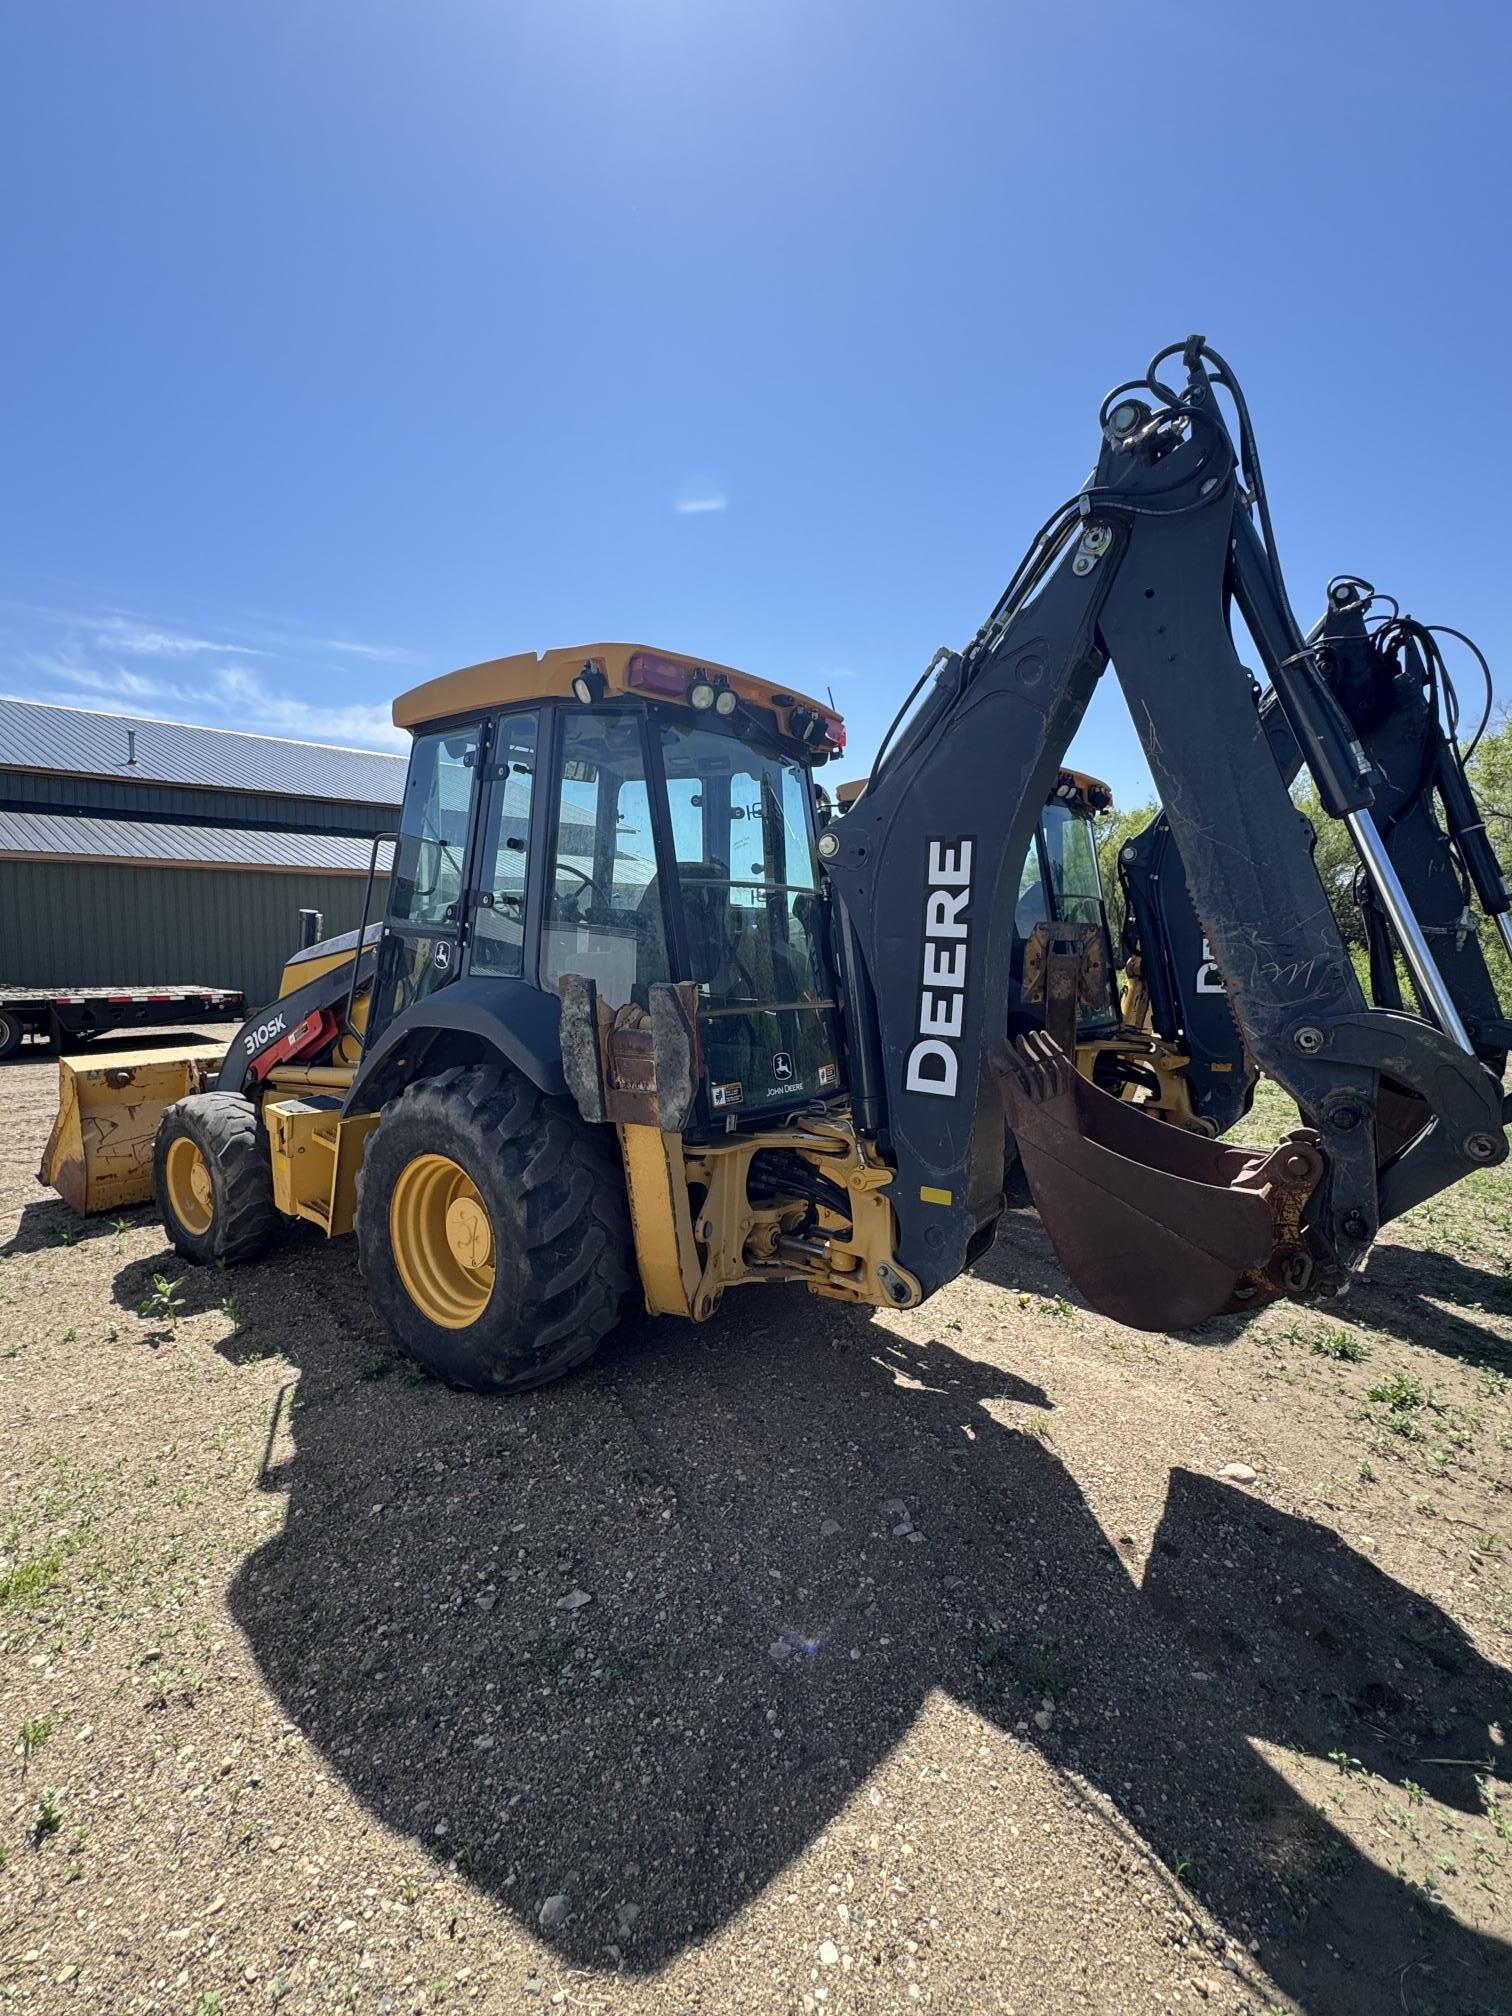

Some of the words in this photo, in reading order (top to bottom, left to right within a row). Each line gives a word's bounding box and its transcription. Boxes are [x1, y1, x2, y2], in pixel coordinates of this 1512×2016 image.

[906, 841, 972, 1097] DEERE
[243, 1013, 287, 1055] 310SK
[766, 1087, 784, 1097] JOHN
[784, 1083, 804, 1093] DEERE
